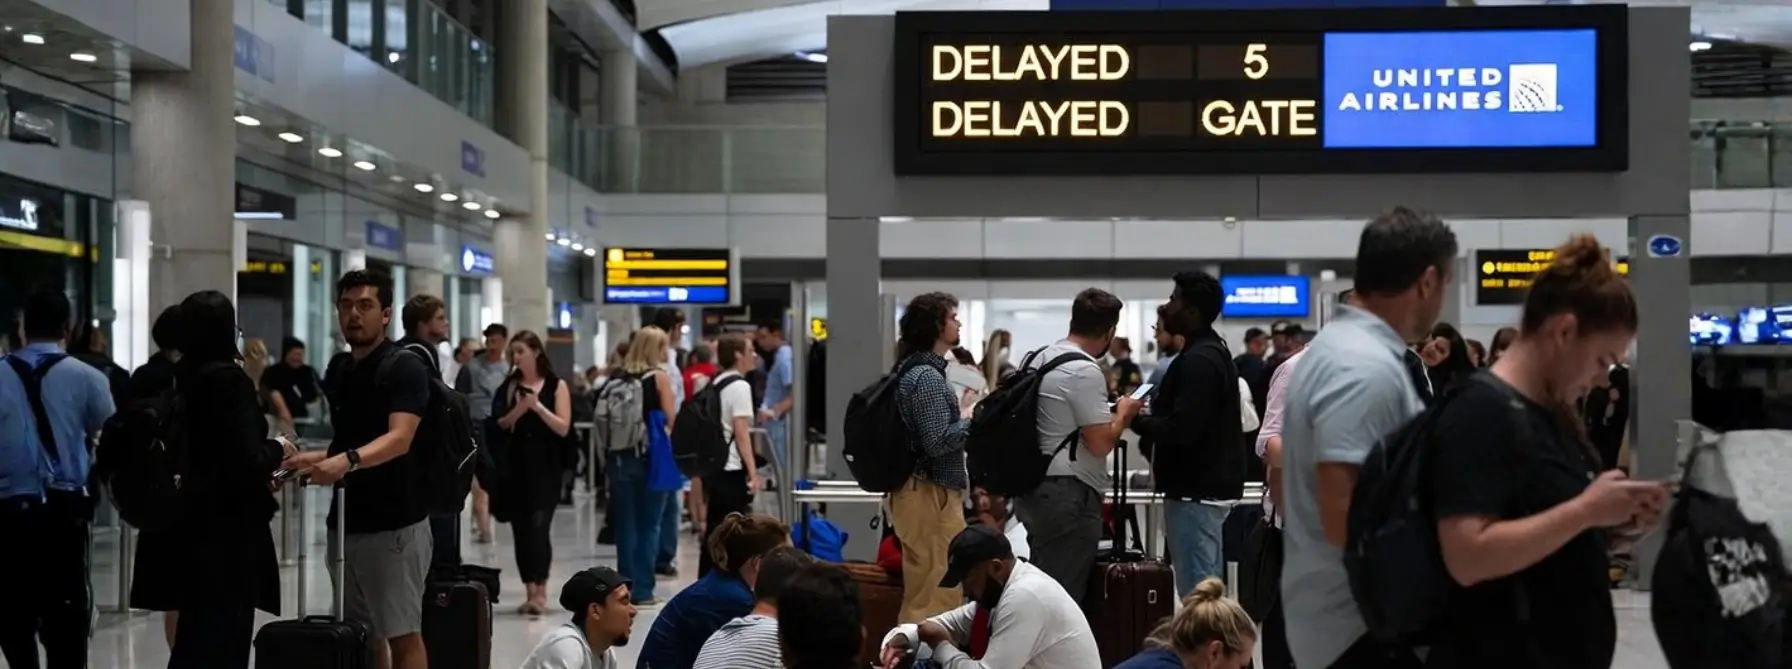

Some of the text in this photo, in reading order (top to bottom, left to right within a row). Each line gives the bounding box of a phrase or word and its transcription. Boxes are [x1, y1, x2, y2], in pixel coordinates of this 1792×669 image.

[932, 43, 1269, 81] DELAYED 5
[1373, 67, 1502, 88] UNITED
[1338, 90, 1502, 111] AIRLINES
[932, 99, 1317, 137] DELAYED GATE
